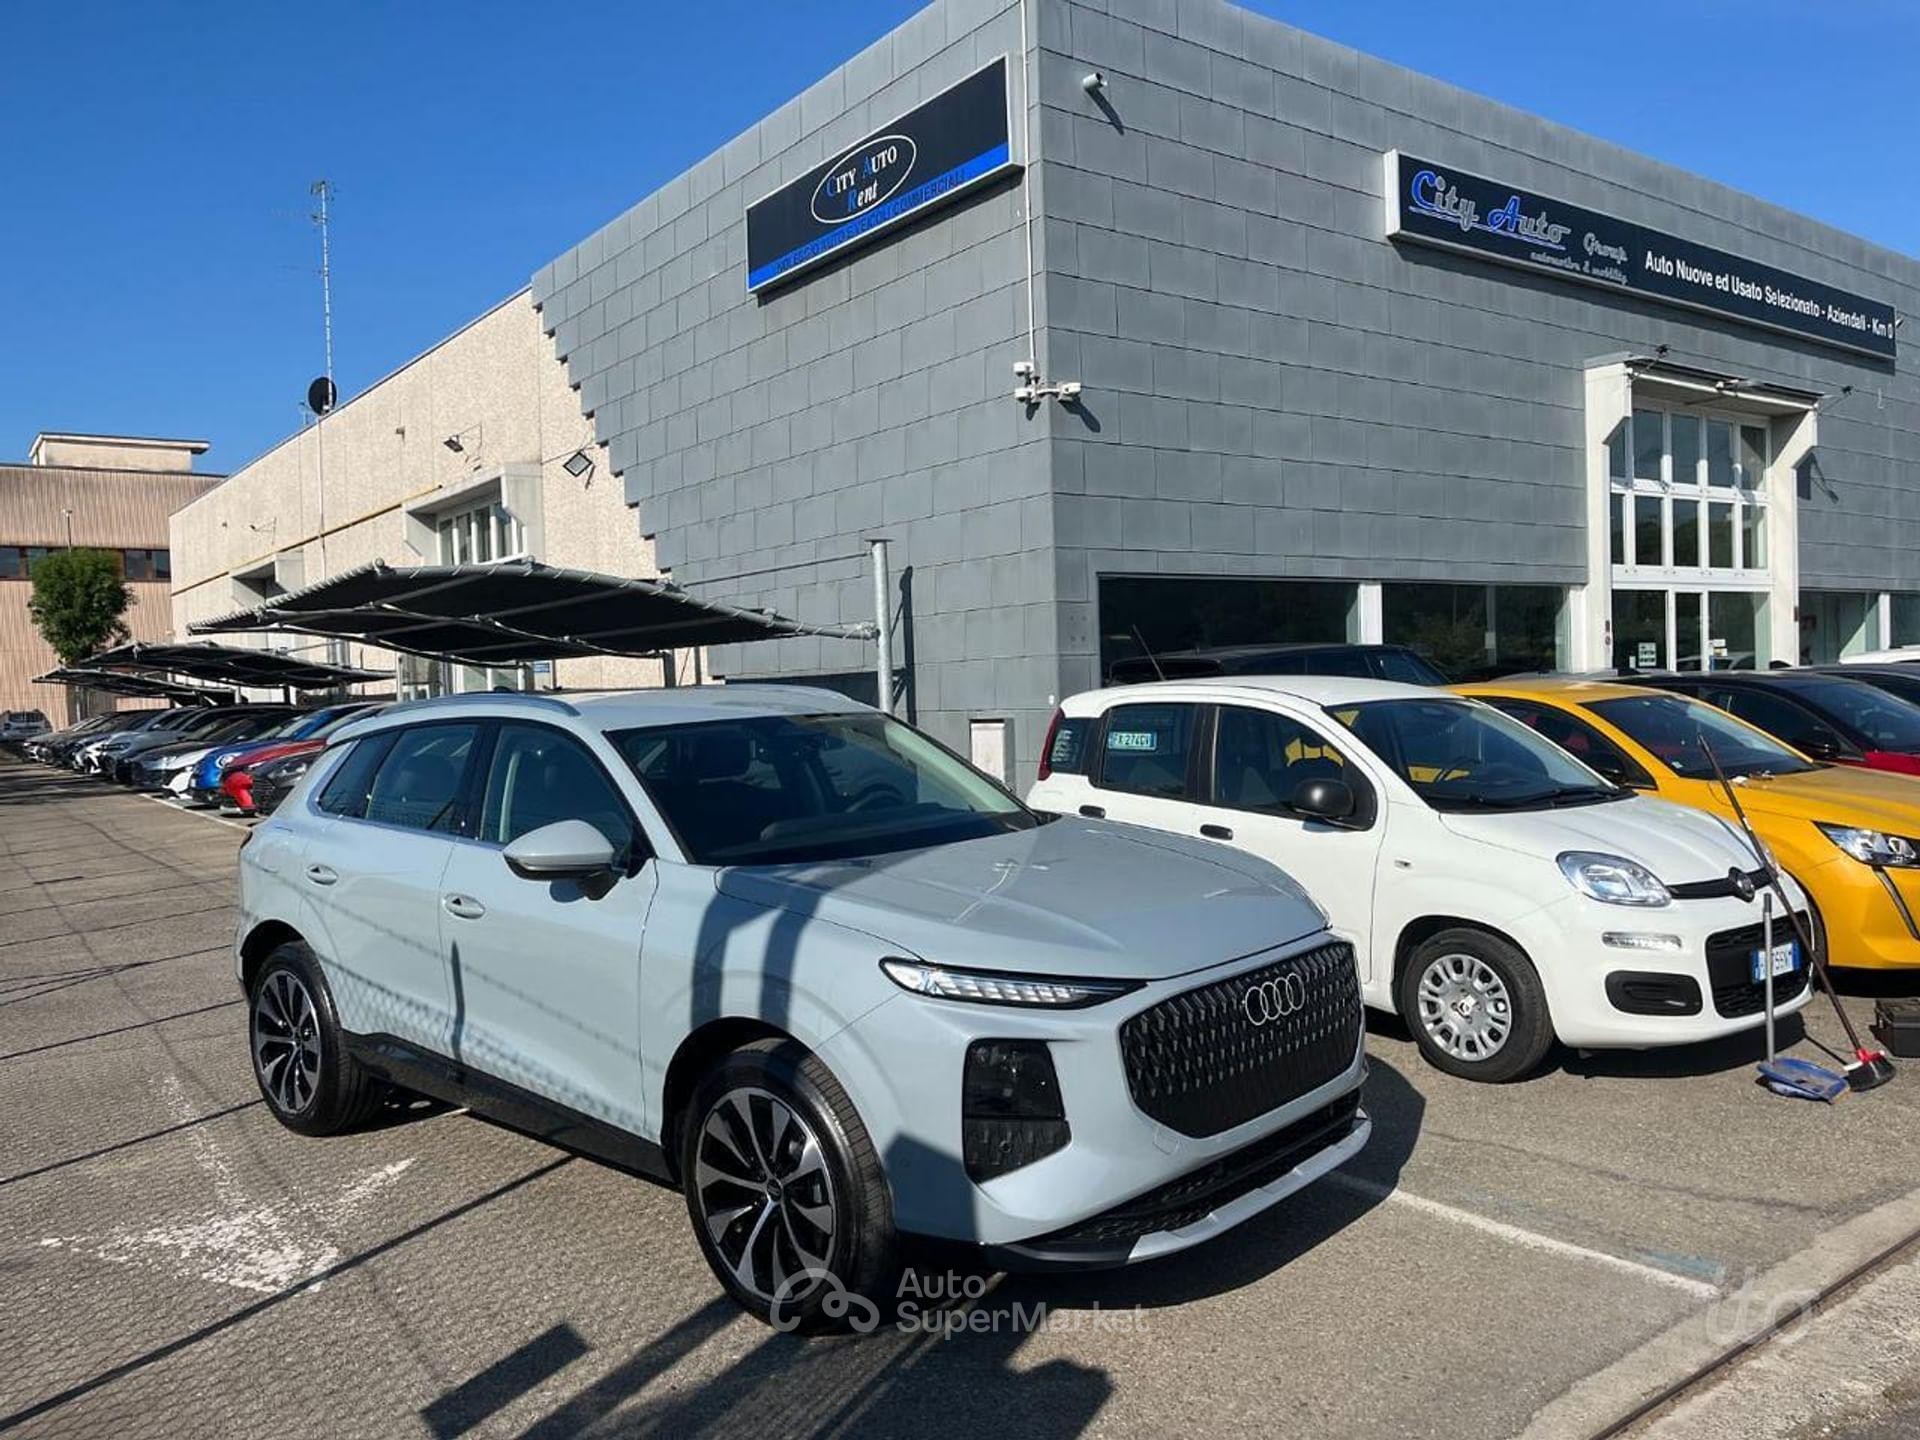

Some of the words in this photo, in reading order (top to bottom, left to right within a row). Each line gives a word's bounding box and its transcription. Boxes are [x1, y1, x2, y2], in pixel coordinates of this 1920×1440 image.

[826, 167, 857, 197] CITY
[862, 145, 898, 179] AUTO
[848, 179, 878, 212] Rent
[1411, 170, 1479, 231] City
[1488, 195, 1571, 243] Auto
[1582, 232, 1628, 264] Group
[1645, 250, 1674, 276] Auto
[1676, 259, 1713, 287] Nuove
[1715, 271, 1730, 292] ed
[1732, 275, 1763, 301] Usato
[1765, 285, 1820, 317] Selezionato
[1827, 304, 1867, 332] Aziendali
[1872, 317, 1887, 338] Km
[1887, 323, 1894, 340] 0
